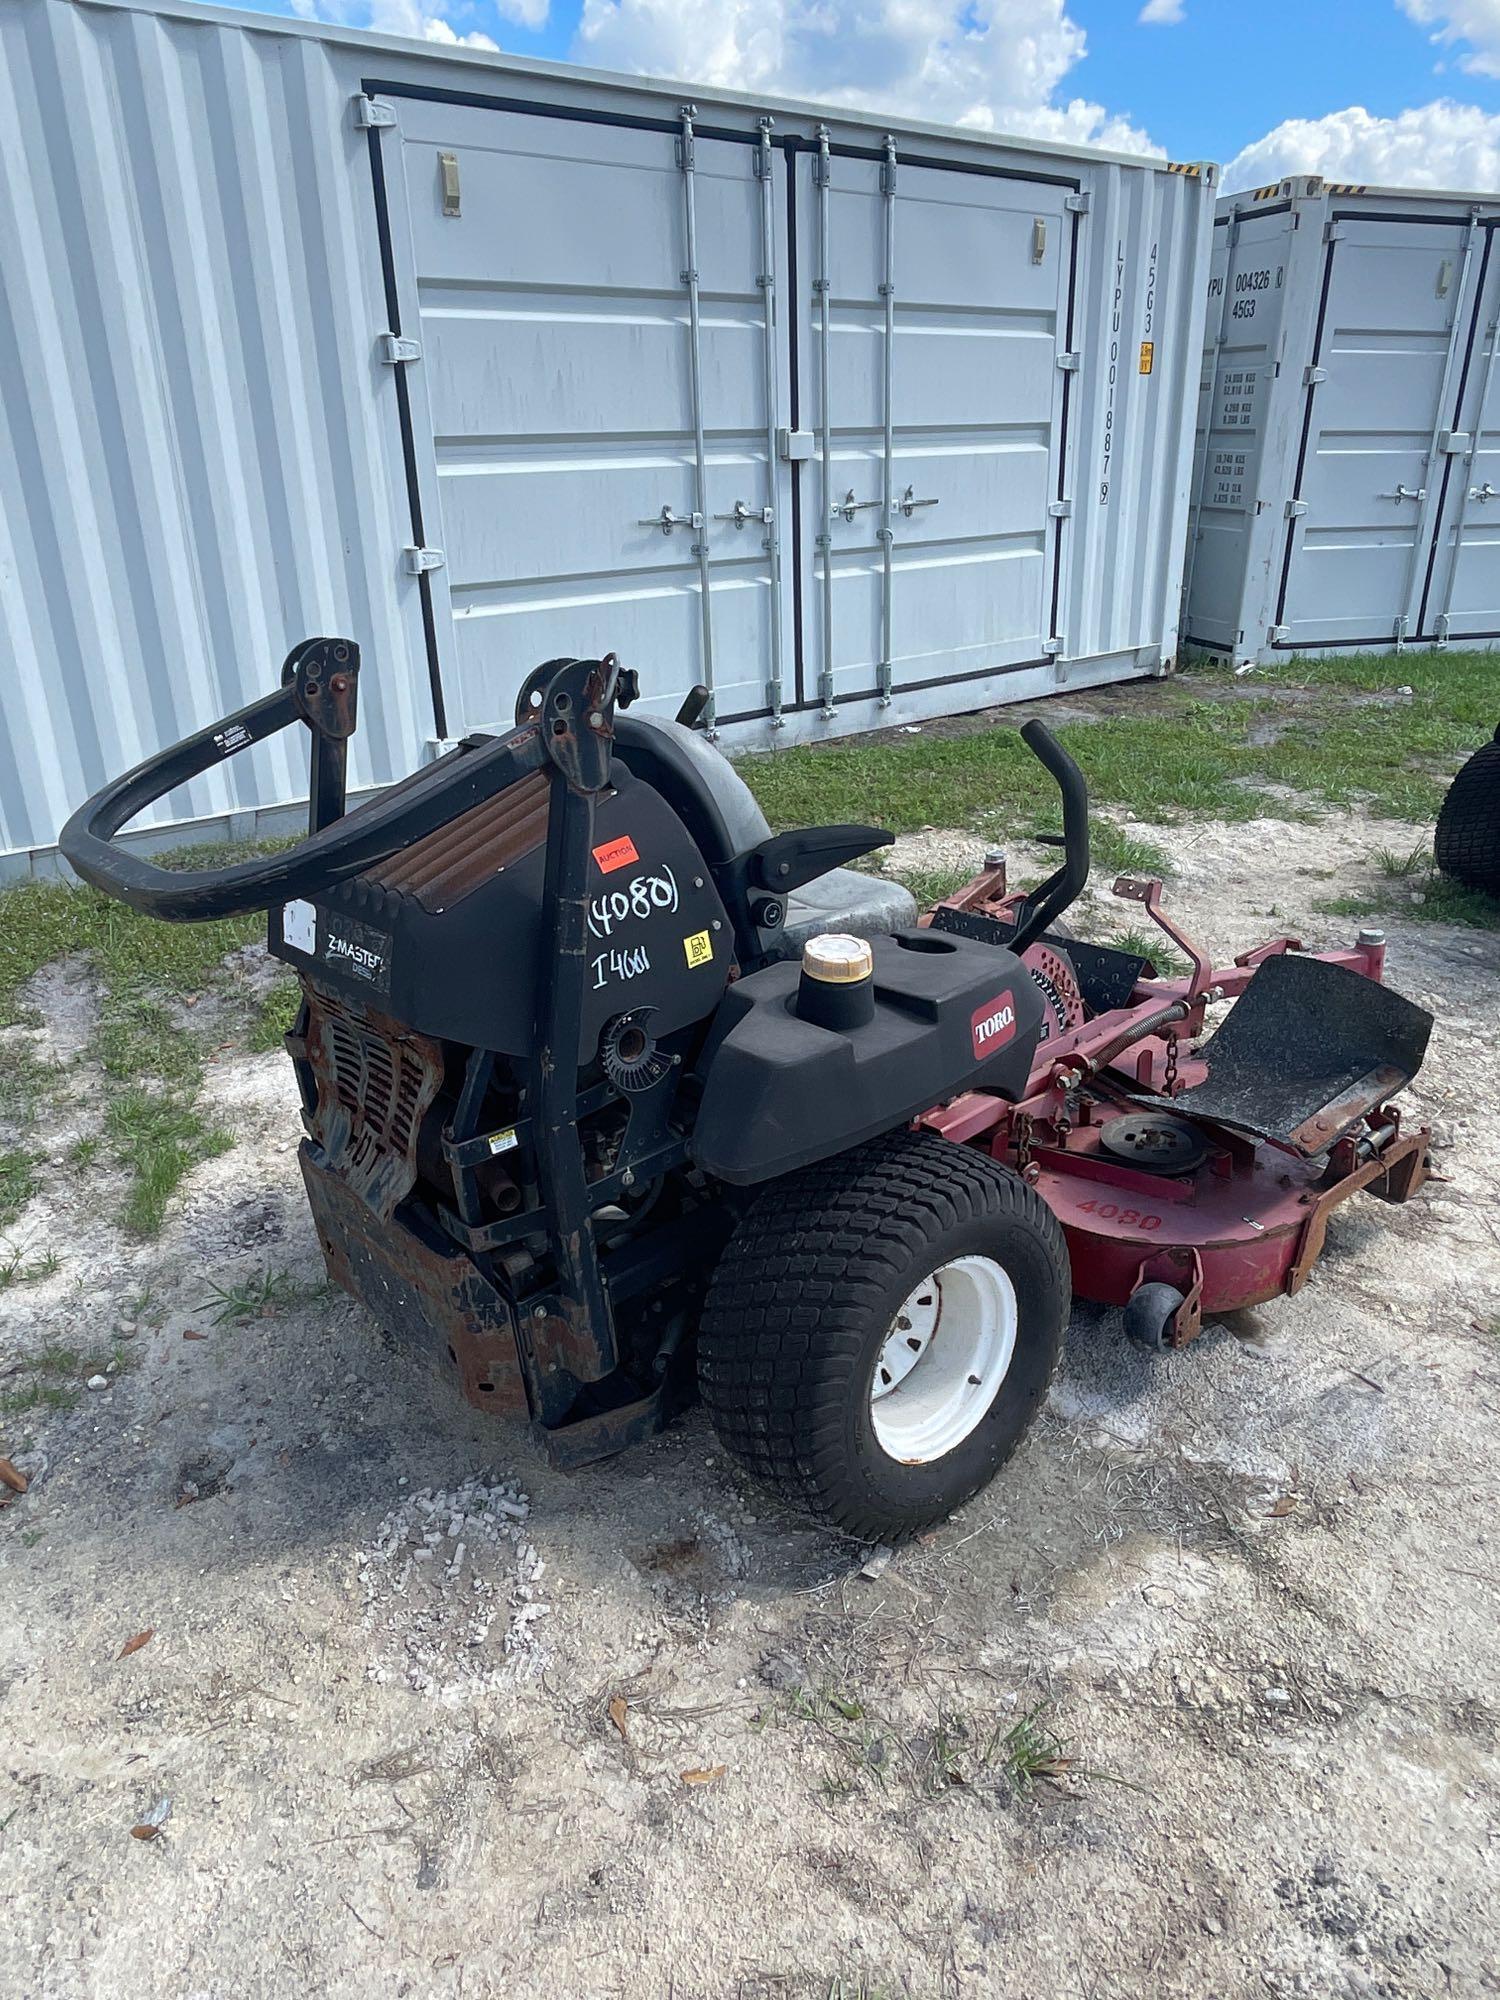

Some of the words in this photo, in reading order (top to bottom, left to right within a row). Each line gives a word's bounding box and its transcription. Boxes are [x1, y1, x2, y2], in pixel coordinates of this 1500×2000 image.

[1144, 242, 1157, 333] 45G3
[1235, 269, 1270, 292] 004326
[1232, 299, 1256, 319] 45G3
[599, 846, 633, 864] AUCTION
[975, 1006, 1014, 1044] TORO
[1075, 1200, 1162, 1230] 4080
